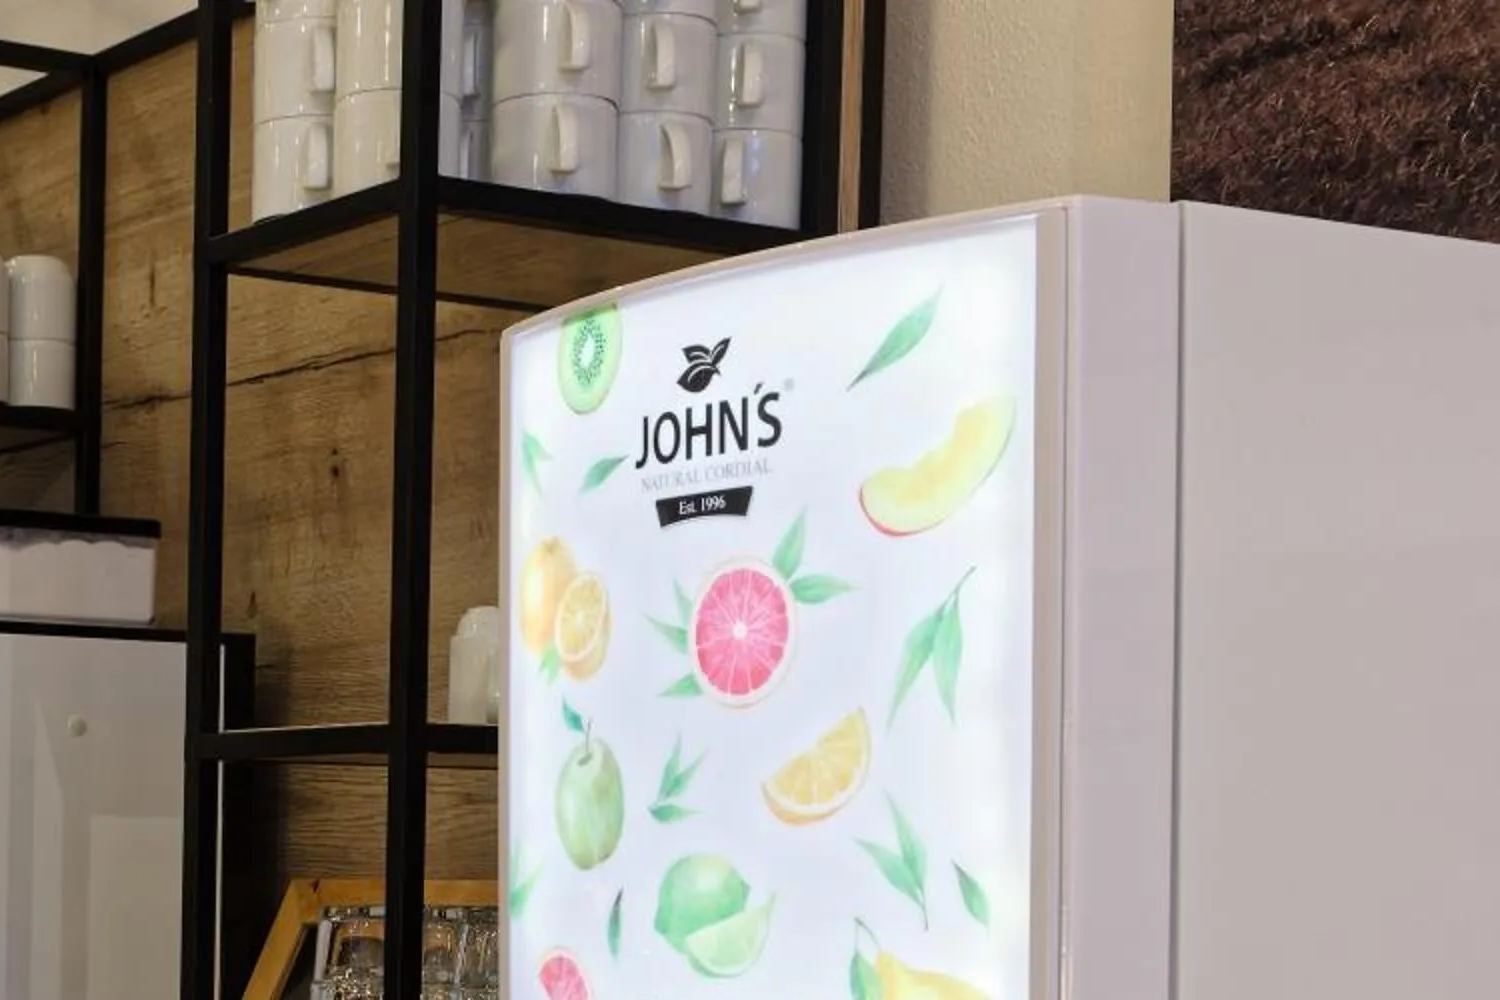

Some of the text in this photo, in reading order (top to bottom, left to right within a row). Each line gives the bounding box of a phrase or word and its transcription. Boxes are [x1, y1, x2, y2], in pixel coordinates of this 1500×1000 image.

[641, 458, 772, 491] NATURAL CORDIAL
[700, 495, 727, 512] 1996
